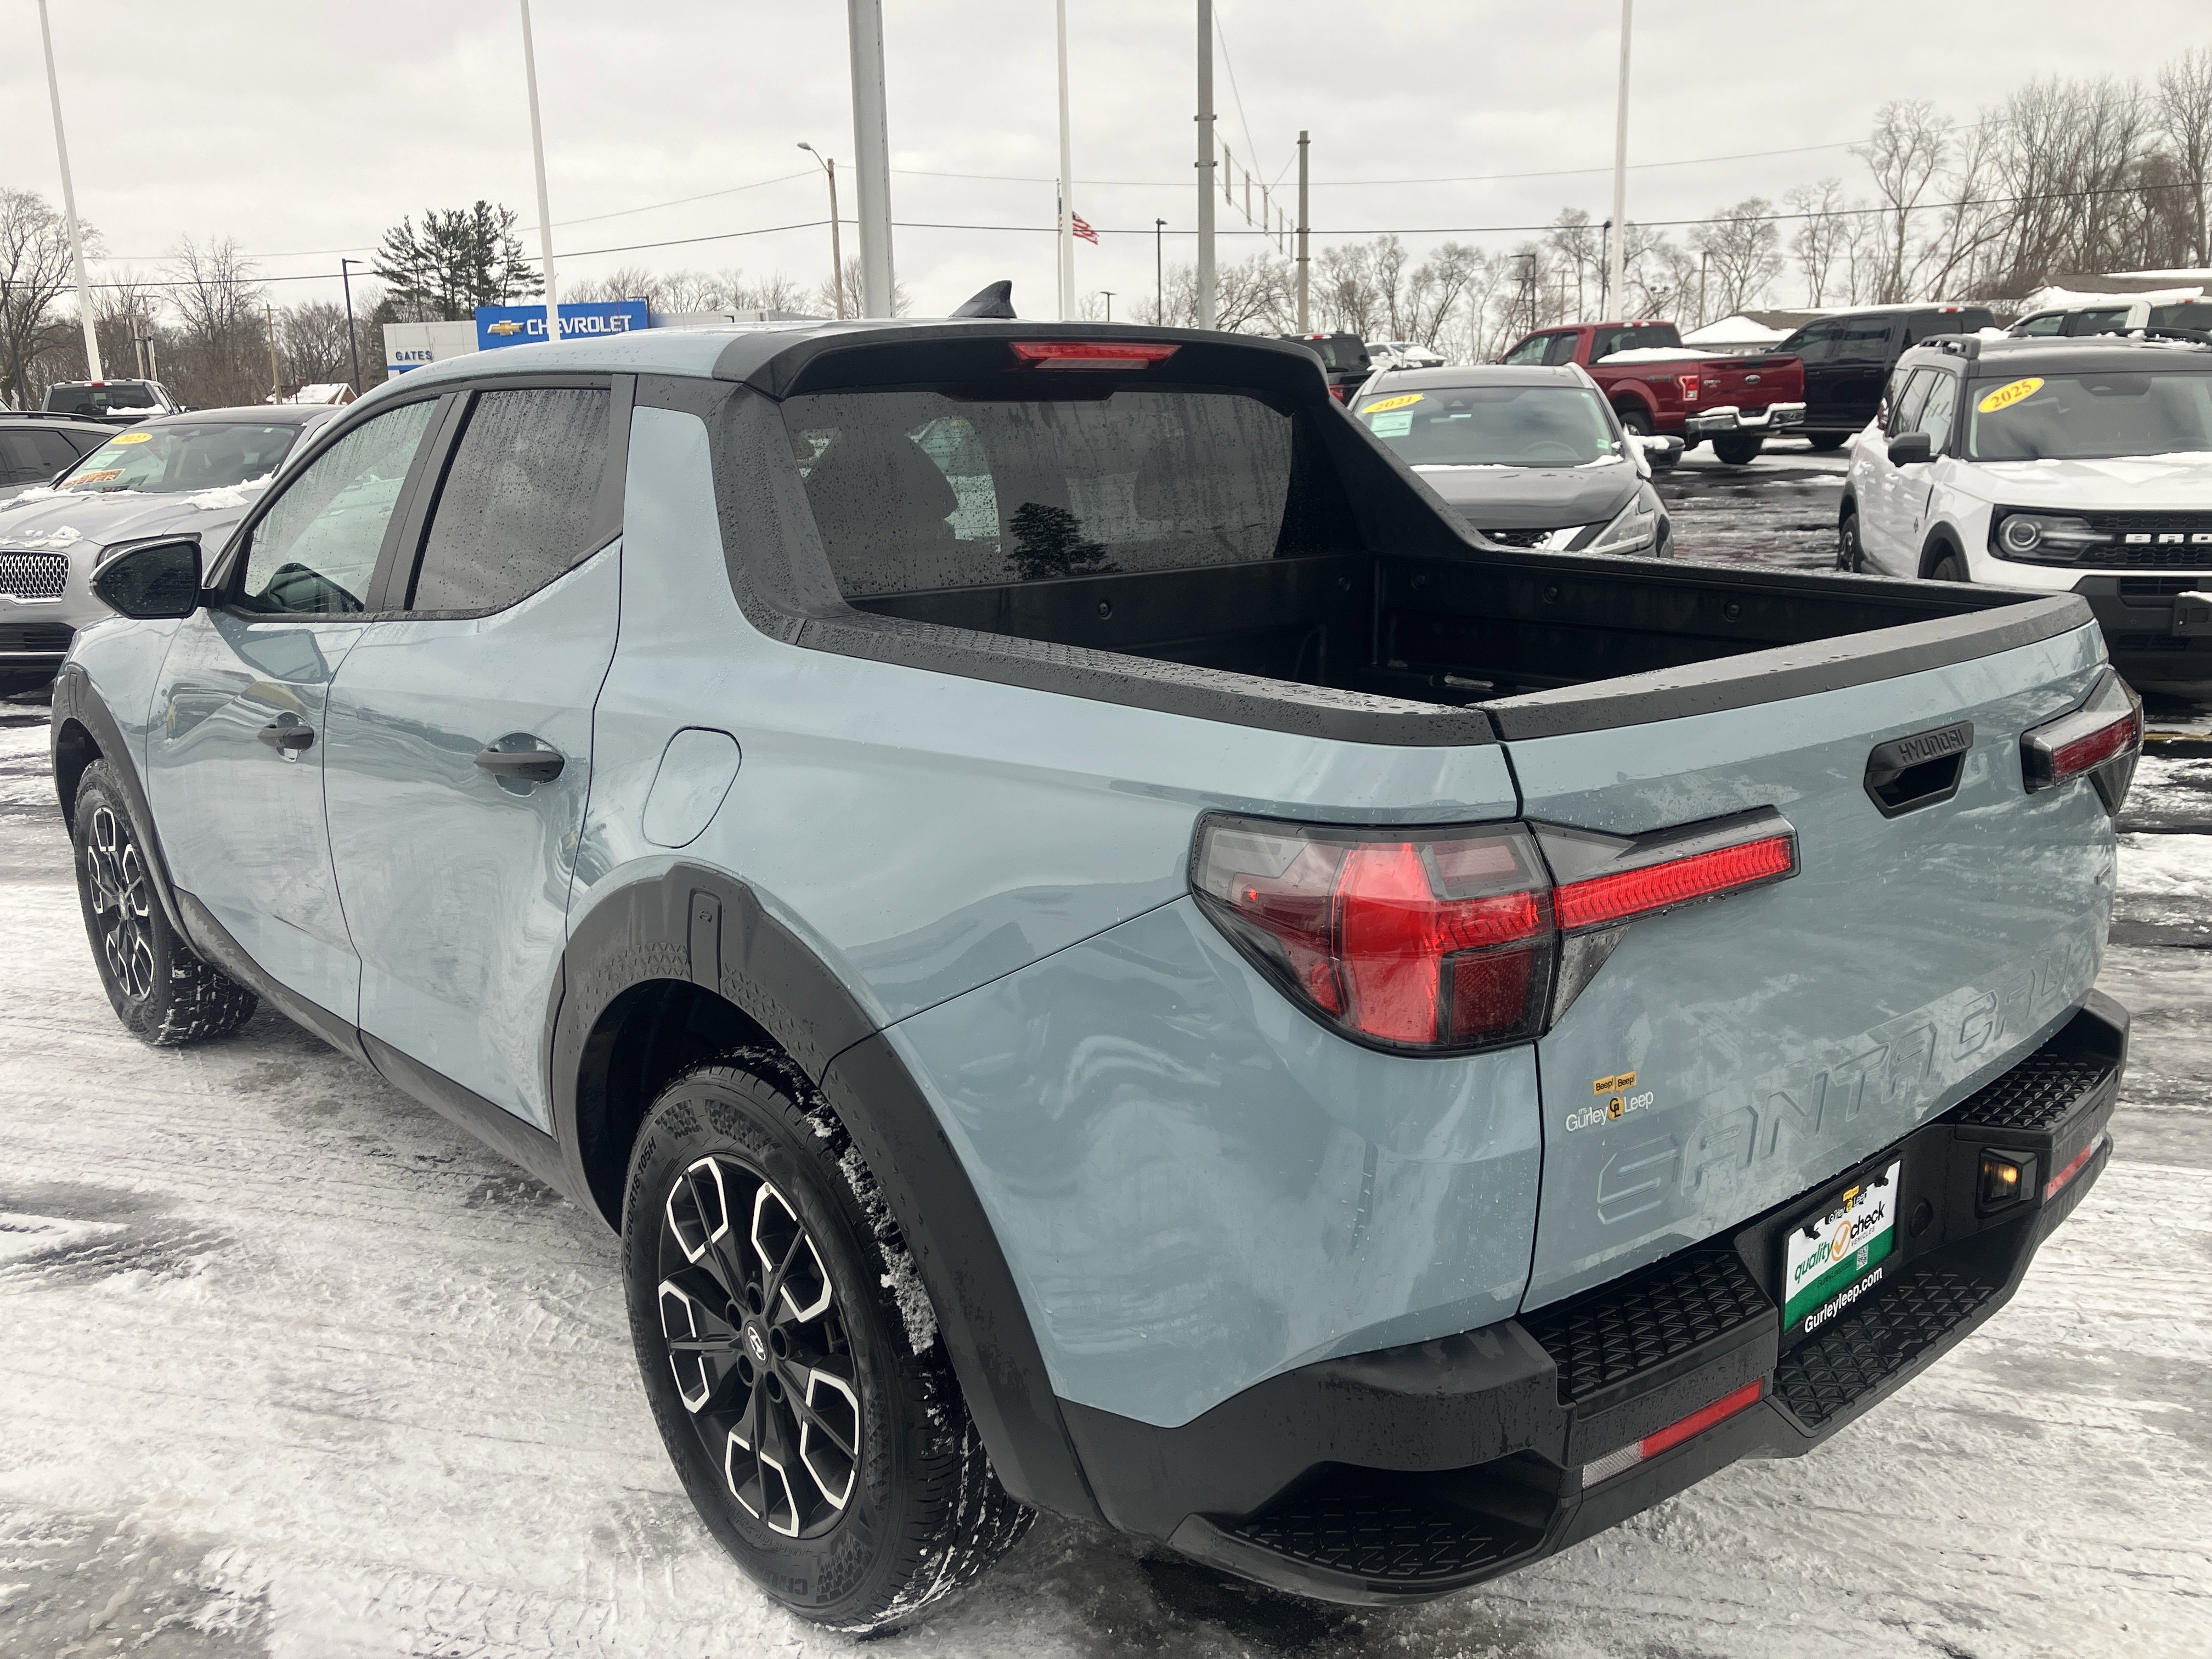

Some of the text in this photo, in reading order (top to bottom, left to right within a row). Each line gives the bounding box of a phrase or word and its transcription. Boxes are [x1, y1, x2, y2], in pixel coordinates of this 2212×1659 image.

[396, 351, 433, 361] GATES
[1375, 396, 1413, 411] 2021
[1990, 381, 2032, 408] 2025
[1898, 728, 1966, 764] HYUNDAI
[1596, 1074, 1635, 1091] Beep! Beep!
[1565, 1106, 1609, 1132] Gurley
[1623, 1091, 1654, 1113] Leep
[1596, 1022, 1938, 1226] SANTA
[629, 1173, 641, 1208] R18
[637, 1135, 657, 1175] 105H
[1795, 1200, 1886, 1284] quality check
[1804, 1267, 1883, 1333] Gurleyleep.com
